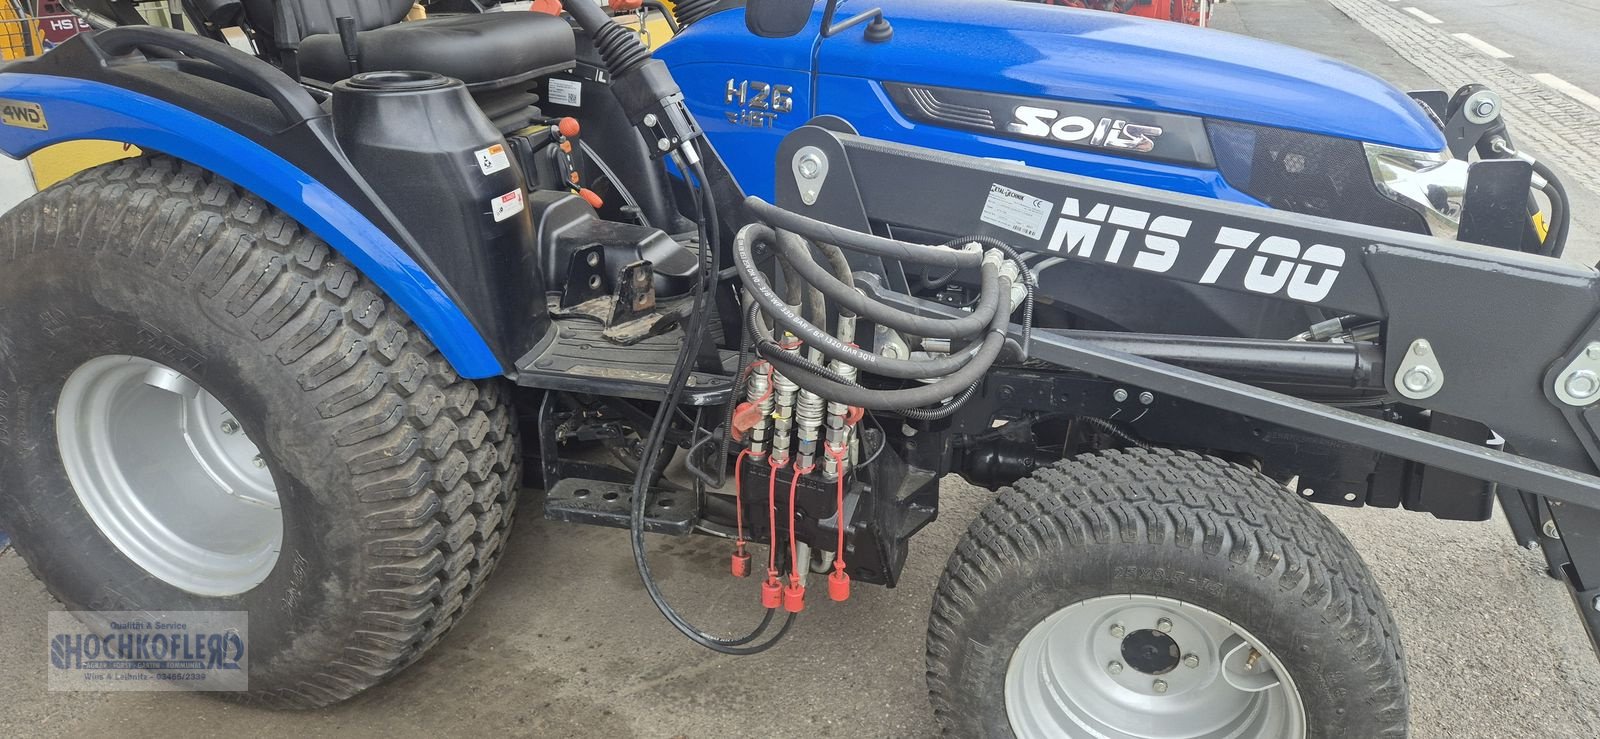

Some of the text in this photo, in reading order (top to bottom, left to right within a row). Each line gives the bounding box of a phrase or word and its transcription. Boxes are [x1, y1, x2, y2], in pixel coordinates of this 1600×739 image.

[50, 19, 73, 31] HS
[726, 78, 793, 112] H26
[3, 105, 40, 123] 4WD
[1047, 197, 1193, 273] MTS
[1199, 226, 1346, 303] 700
[780, 306, 795, 318] 330
[792, 316, 808, 329] BAR
[824, 336, 842, 348] 1320
[842, 345, 858, 356] BAR
